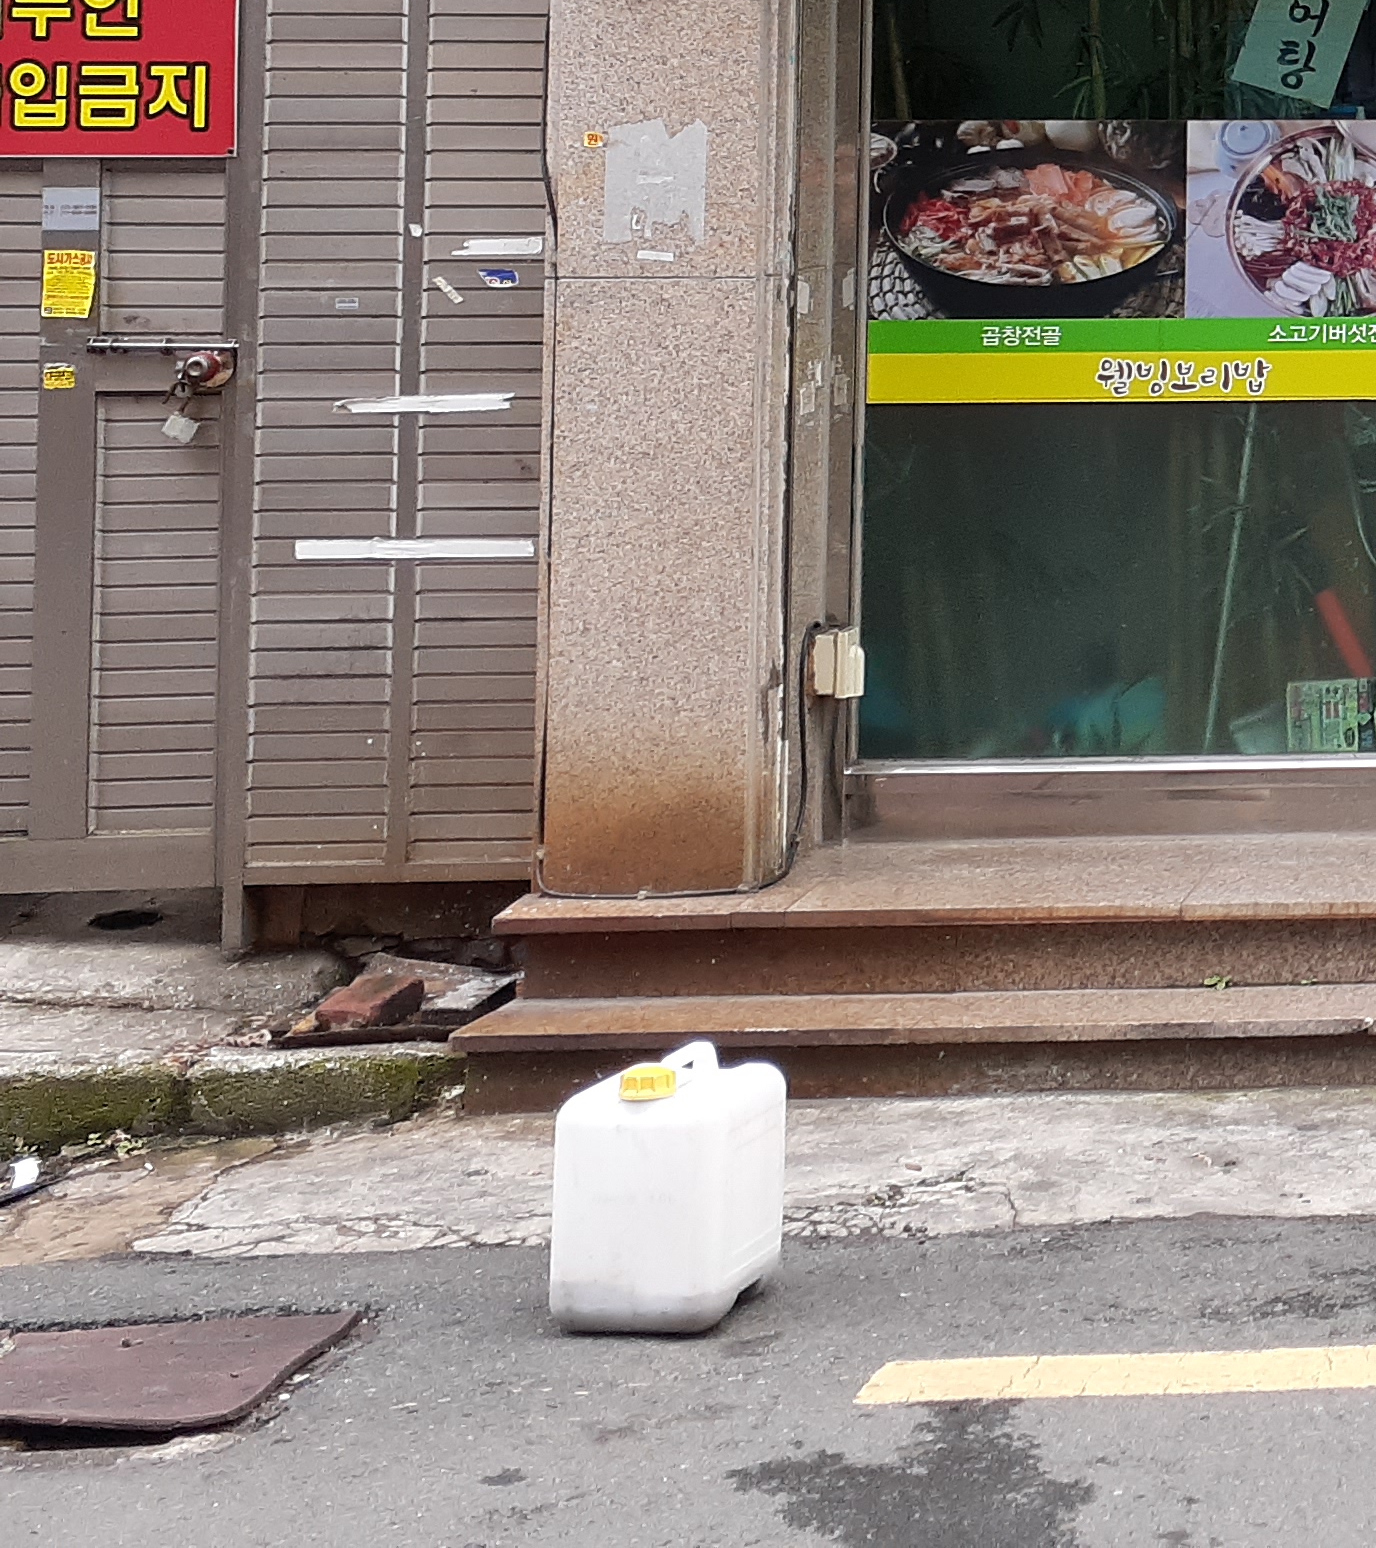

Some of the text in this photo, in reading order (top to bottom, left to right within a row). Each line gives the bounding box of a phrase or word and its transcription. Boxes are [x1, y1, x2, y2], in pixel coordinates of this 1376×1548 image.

[0, 61, 210, 131] 입금지
[981, 324, 1062, 348] 곱창전골
[1095, 355, 1273, 397] 웰빙보리밥
